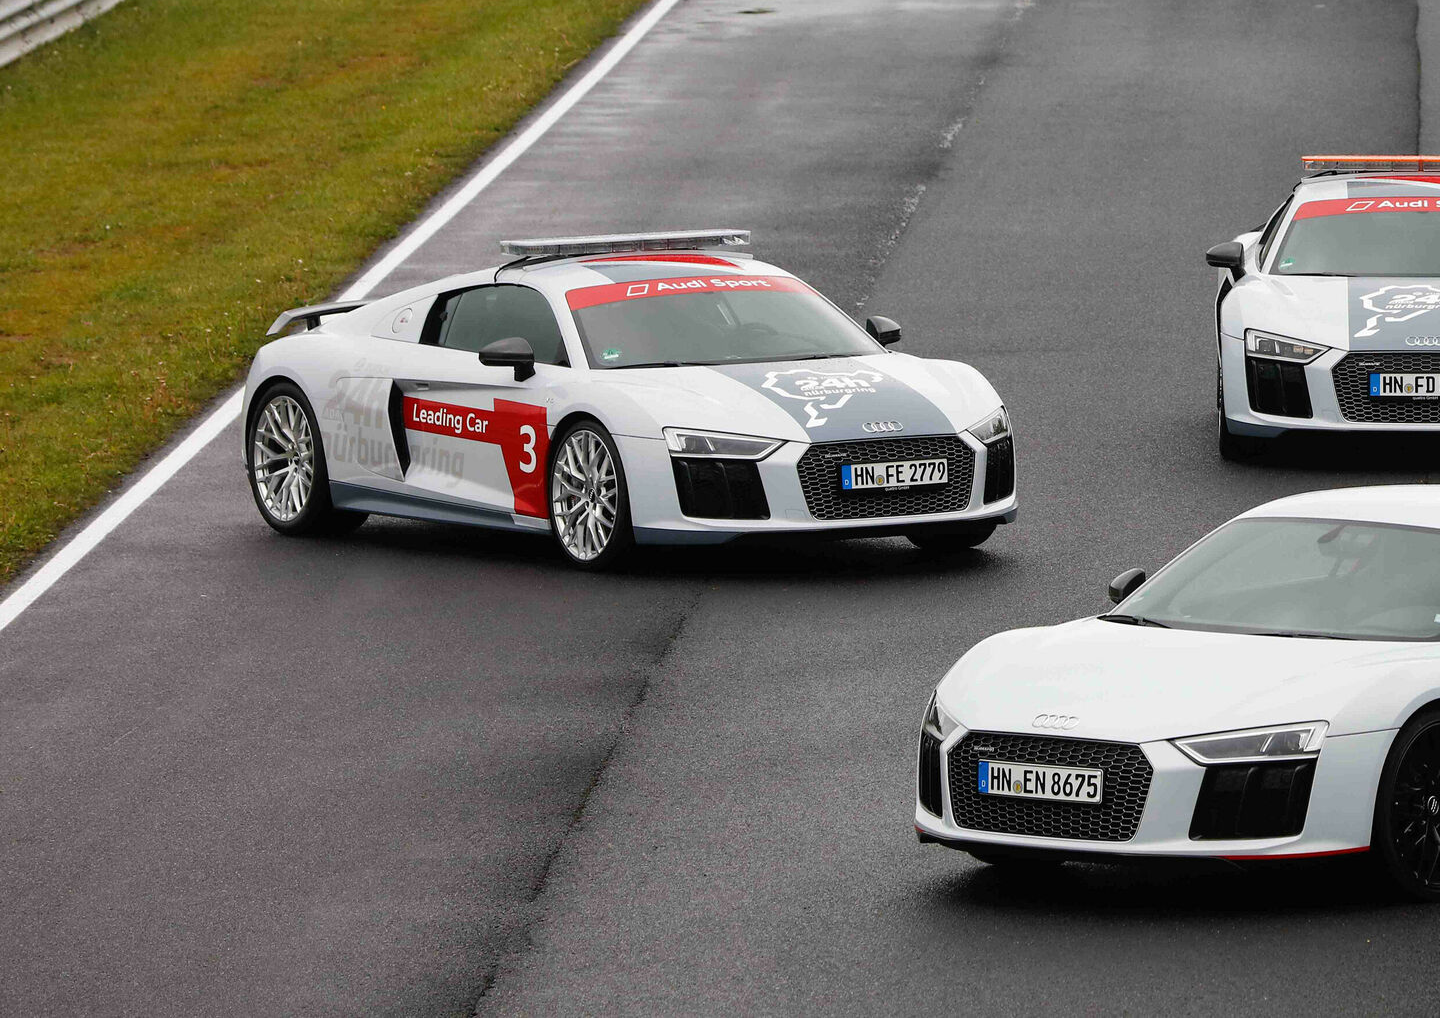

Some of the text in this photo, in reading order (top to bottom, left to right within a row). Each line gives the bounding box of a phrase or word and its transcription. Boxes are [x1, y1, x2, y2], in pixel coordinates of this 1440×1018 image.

[1377, 200, 1429, 209] Audi
[657, 279, 772, 291] Audi Sport
[795, 377, 871, 389] 24h
[1382, 376, 1404, 393] HN
[1414, 376, 1436, 393] FD
[412, 403, 489, 434] Leading Car
[519, 424, 537, 474] 3
[854, 466, 875, 486] HN
[885, 464, 906, 484] FE
[909, 461, 946, 483] 2779
[981, 766, 1098, 799] D HN EN 8675
